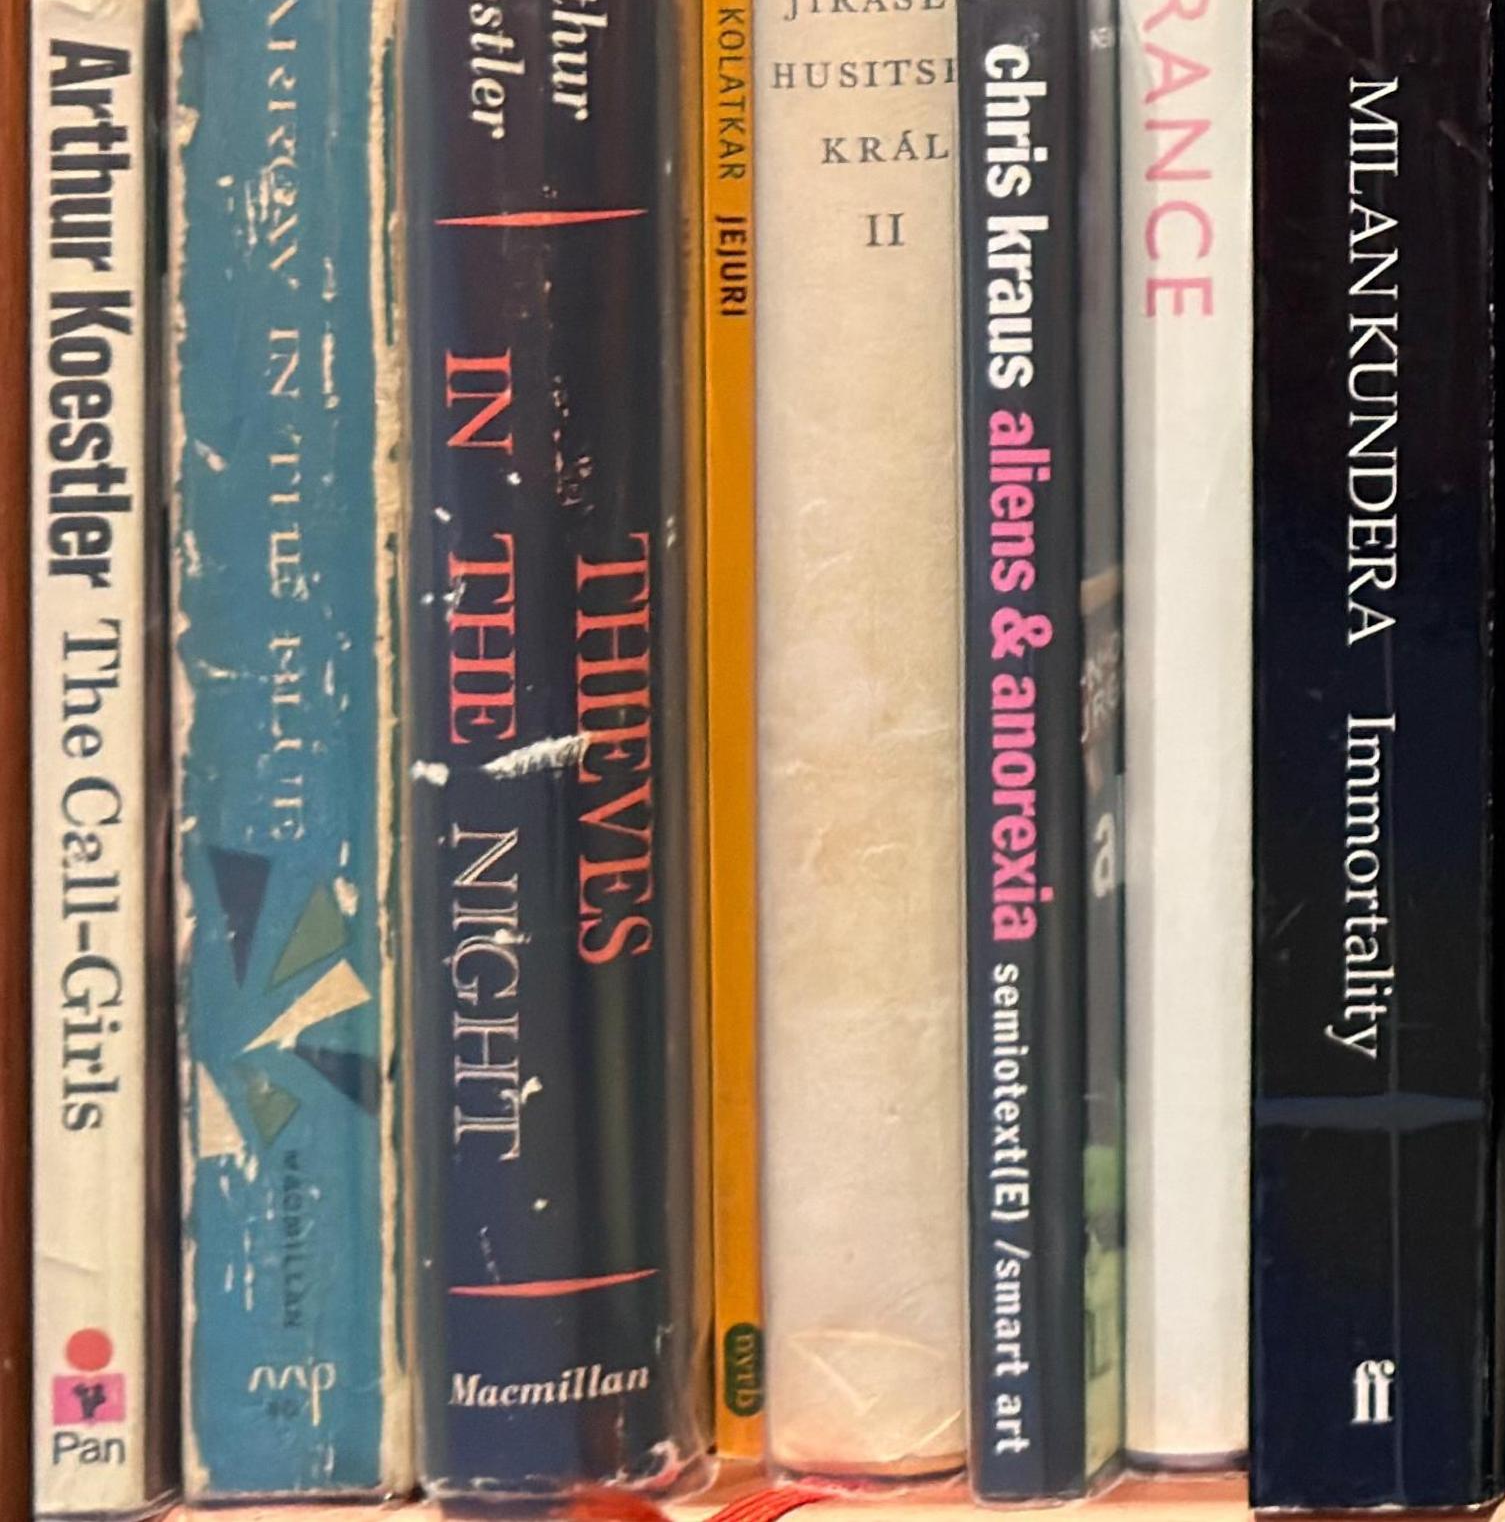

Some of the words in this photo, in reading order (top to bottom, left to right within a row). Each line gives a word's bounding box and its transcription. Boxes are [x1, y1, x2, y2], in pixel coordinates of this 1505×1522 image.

[48, 38, 131, 271] Arthur
[717, 7, 751, 180] KOLATKAR
[821, 129, 949, 164] KRÁL
[983, 44, 1046, 197] chris
[716, 215, 748, 317] JEJURI
[866, 213, 904, 247] II
[1348, 77, 1397, 298] MILAN
[986, 218, 1049, 387] kraus
[46, 292, 135, 589] Koestler
[444, 348, 514, 454] IN
[1347, 301, 1396, 646] KUNDERA
[987, 409, 1050, 593] aliens
[60, 618, 122, 759] The
[447, 532, 517, 747] THE
[989, 608, 1052, 656] &
[576, 532, 651, 964] THIEVES
[990, 677, 1053, 942] anorexia
[60, 772, 124, 1132] Call-Girls
[1325, 713, 1393, 1060] Immortality
[452, 825, 519, 1161] NIGHT
[990, 964, 1031, 1221] semiotext(E)
[52, 1432, 125, 1466] Pan
[450, 1364, 648, 1408] Macmillan
[993, 1393, 1031, 1454] art
[1354, 1359, 1393, 1423] ff
